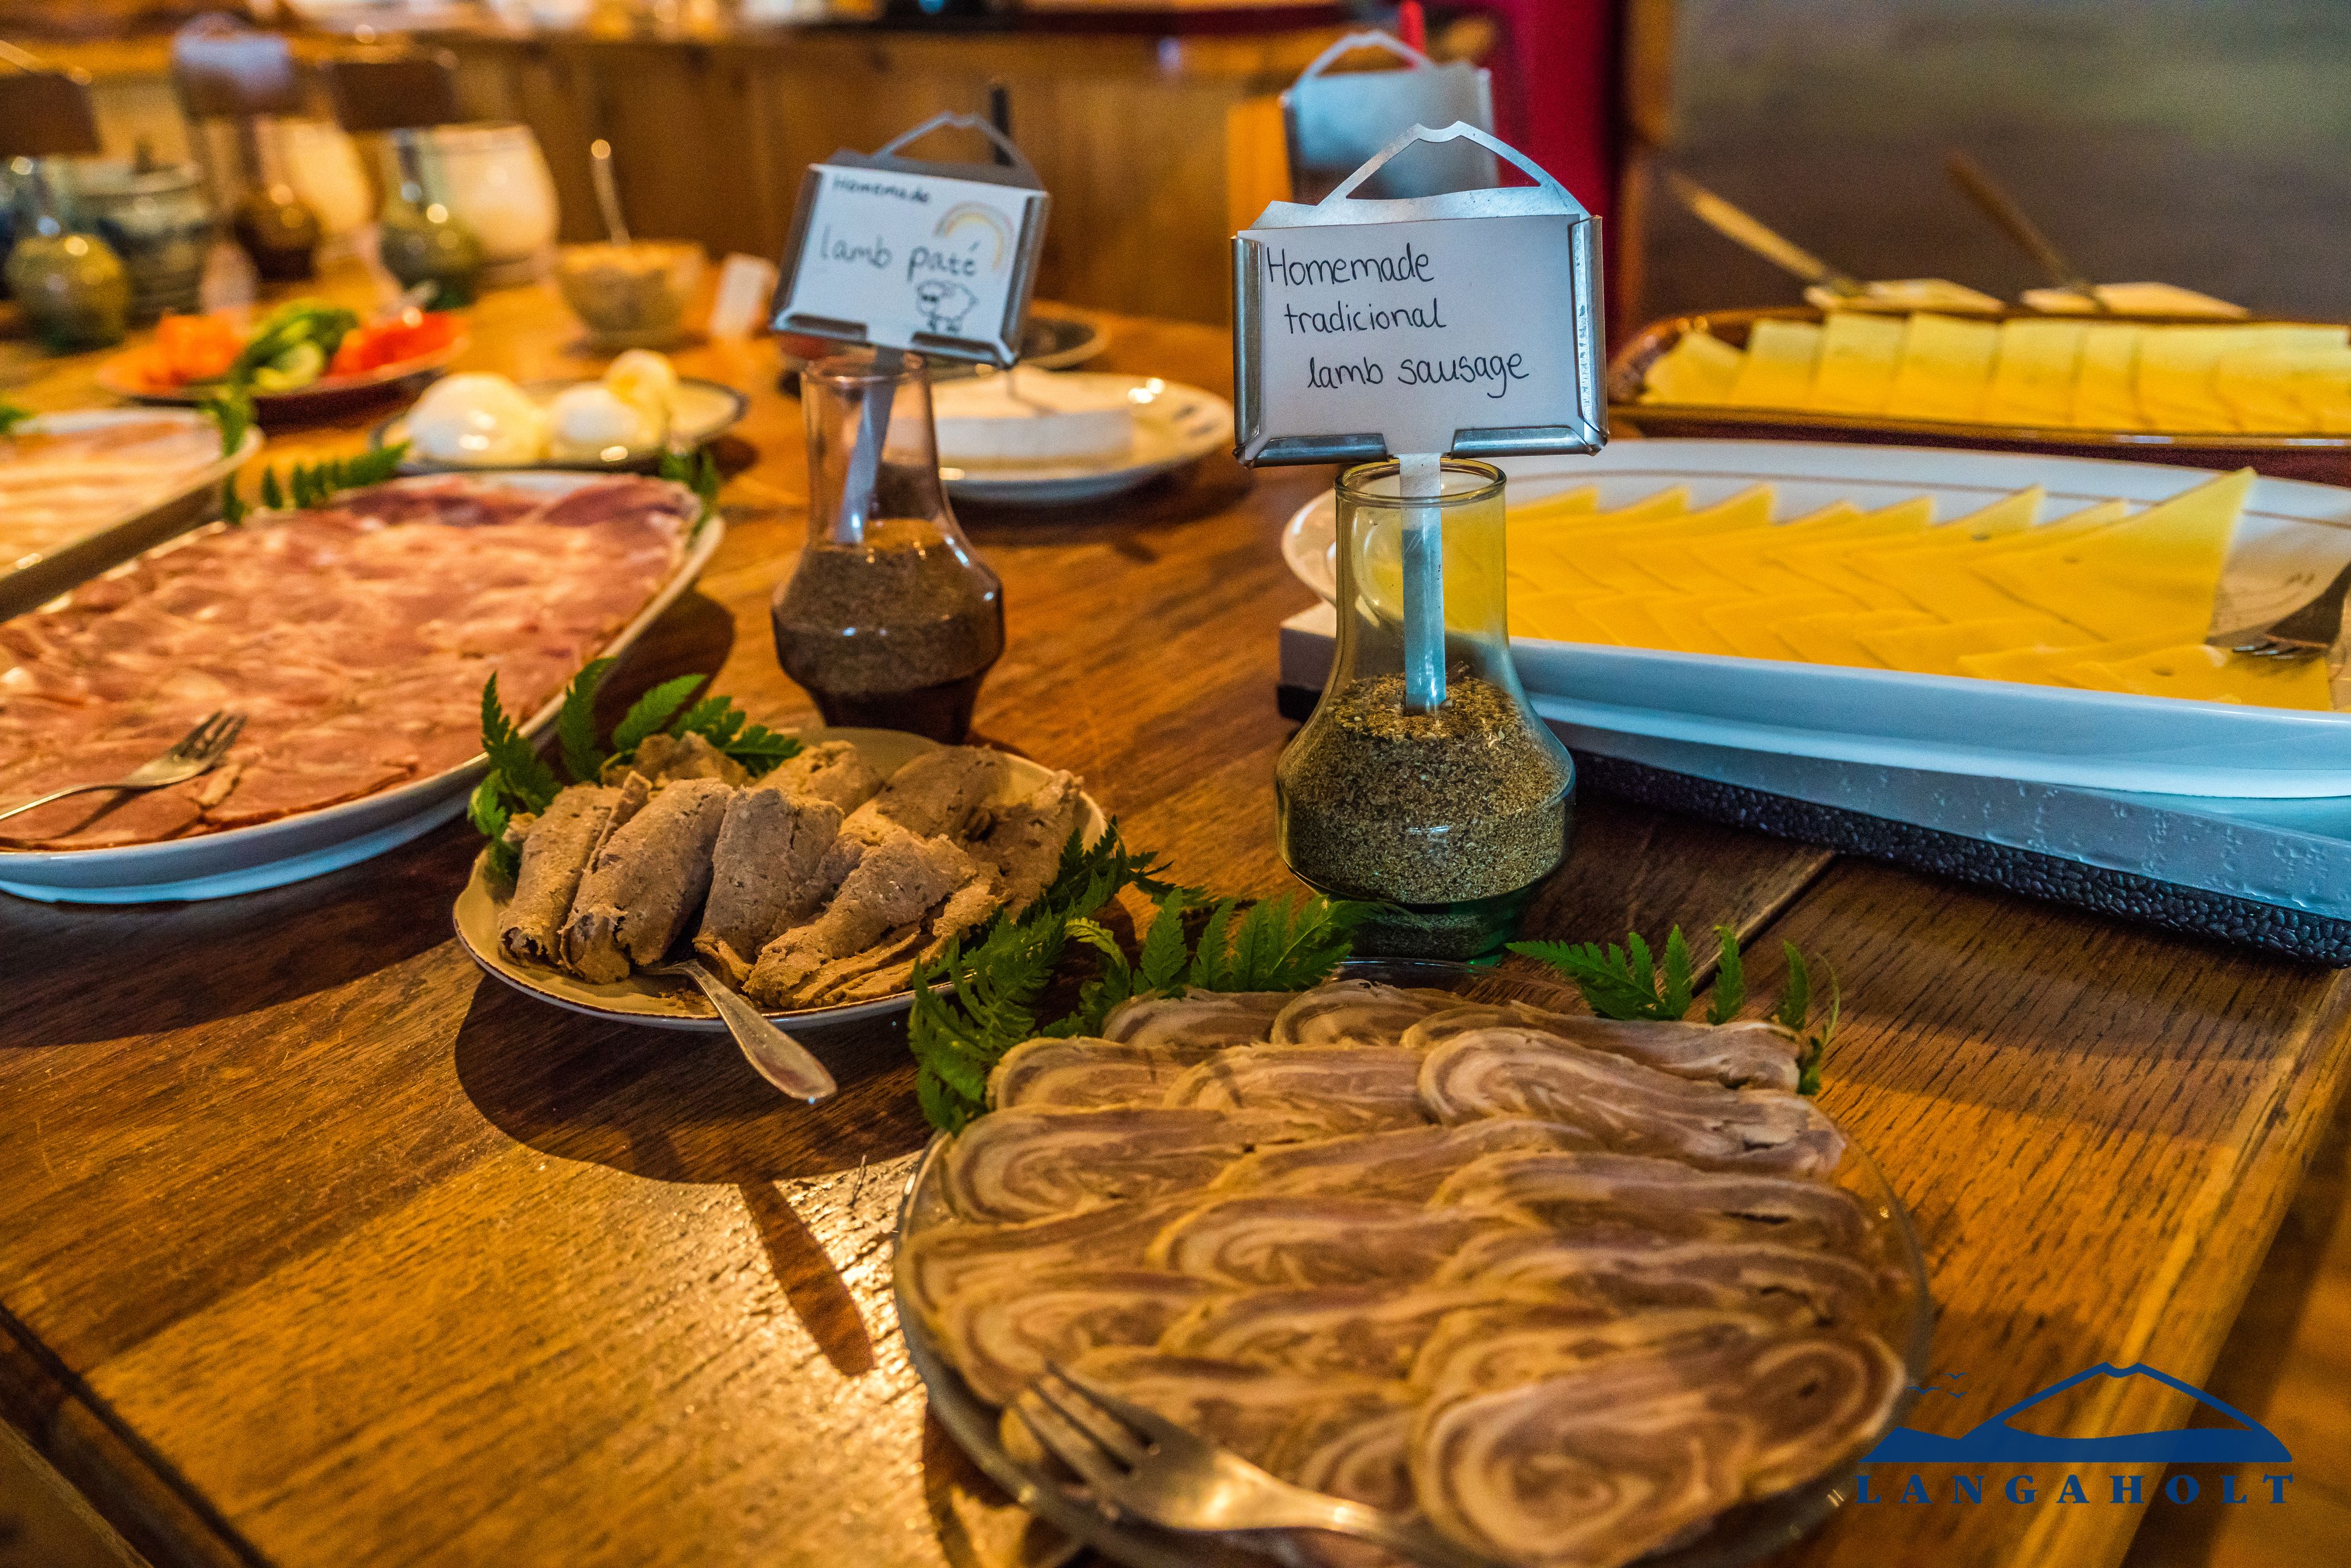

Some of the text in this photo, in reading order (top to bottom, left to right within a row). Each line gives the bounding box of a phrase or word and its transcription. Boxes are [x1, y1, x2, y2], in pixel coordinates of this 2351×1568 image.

[833, 174, 930, 203] Homemade
[820, 225, 892, 269] lamb
[1267, 242, 1434, 286] Homemade
[1284, 298, 1447, 334] tradicional
[1307, 353, 1529, 399] lamb sausage
